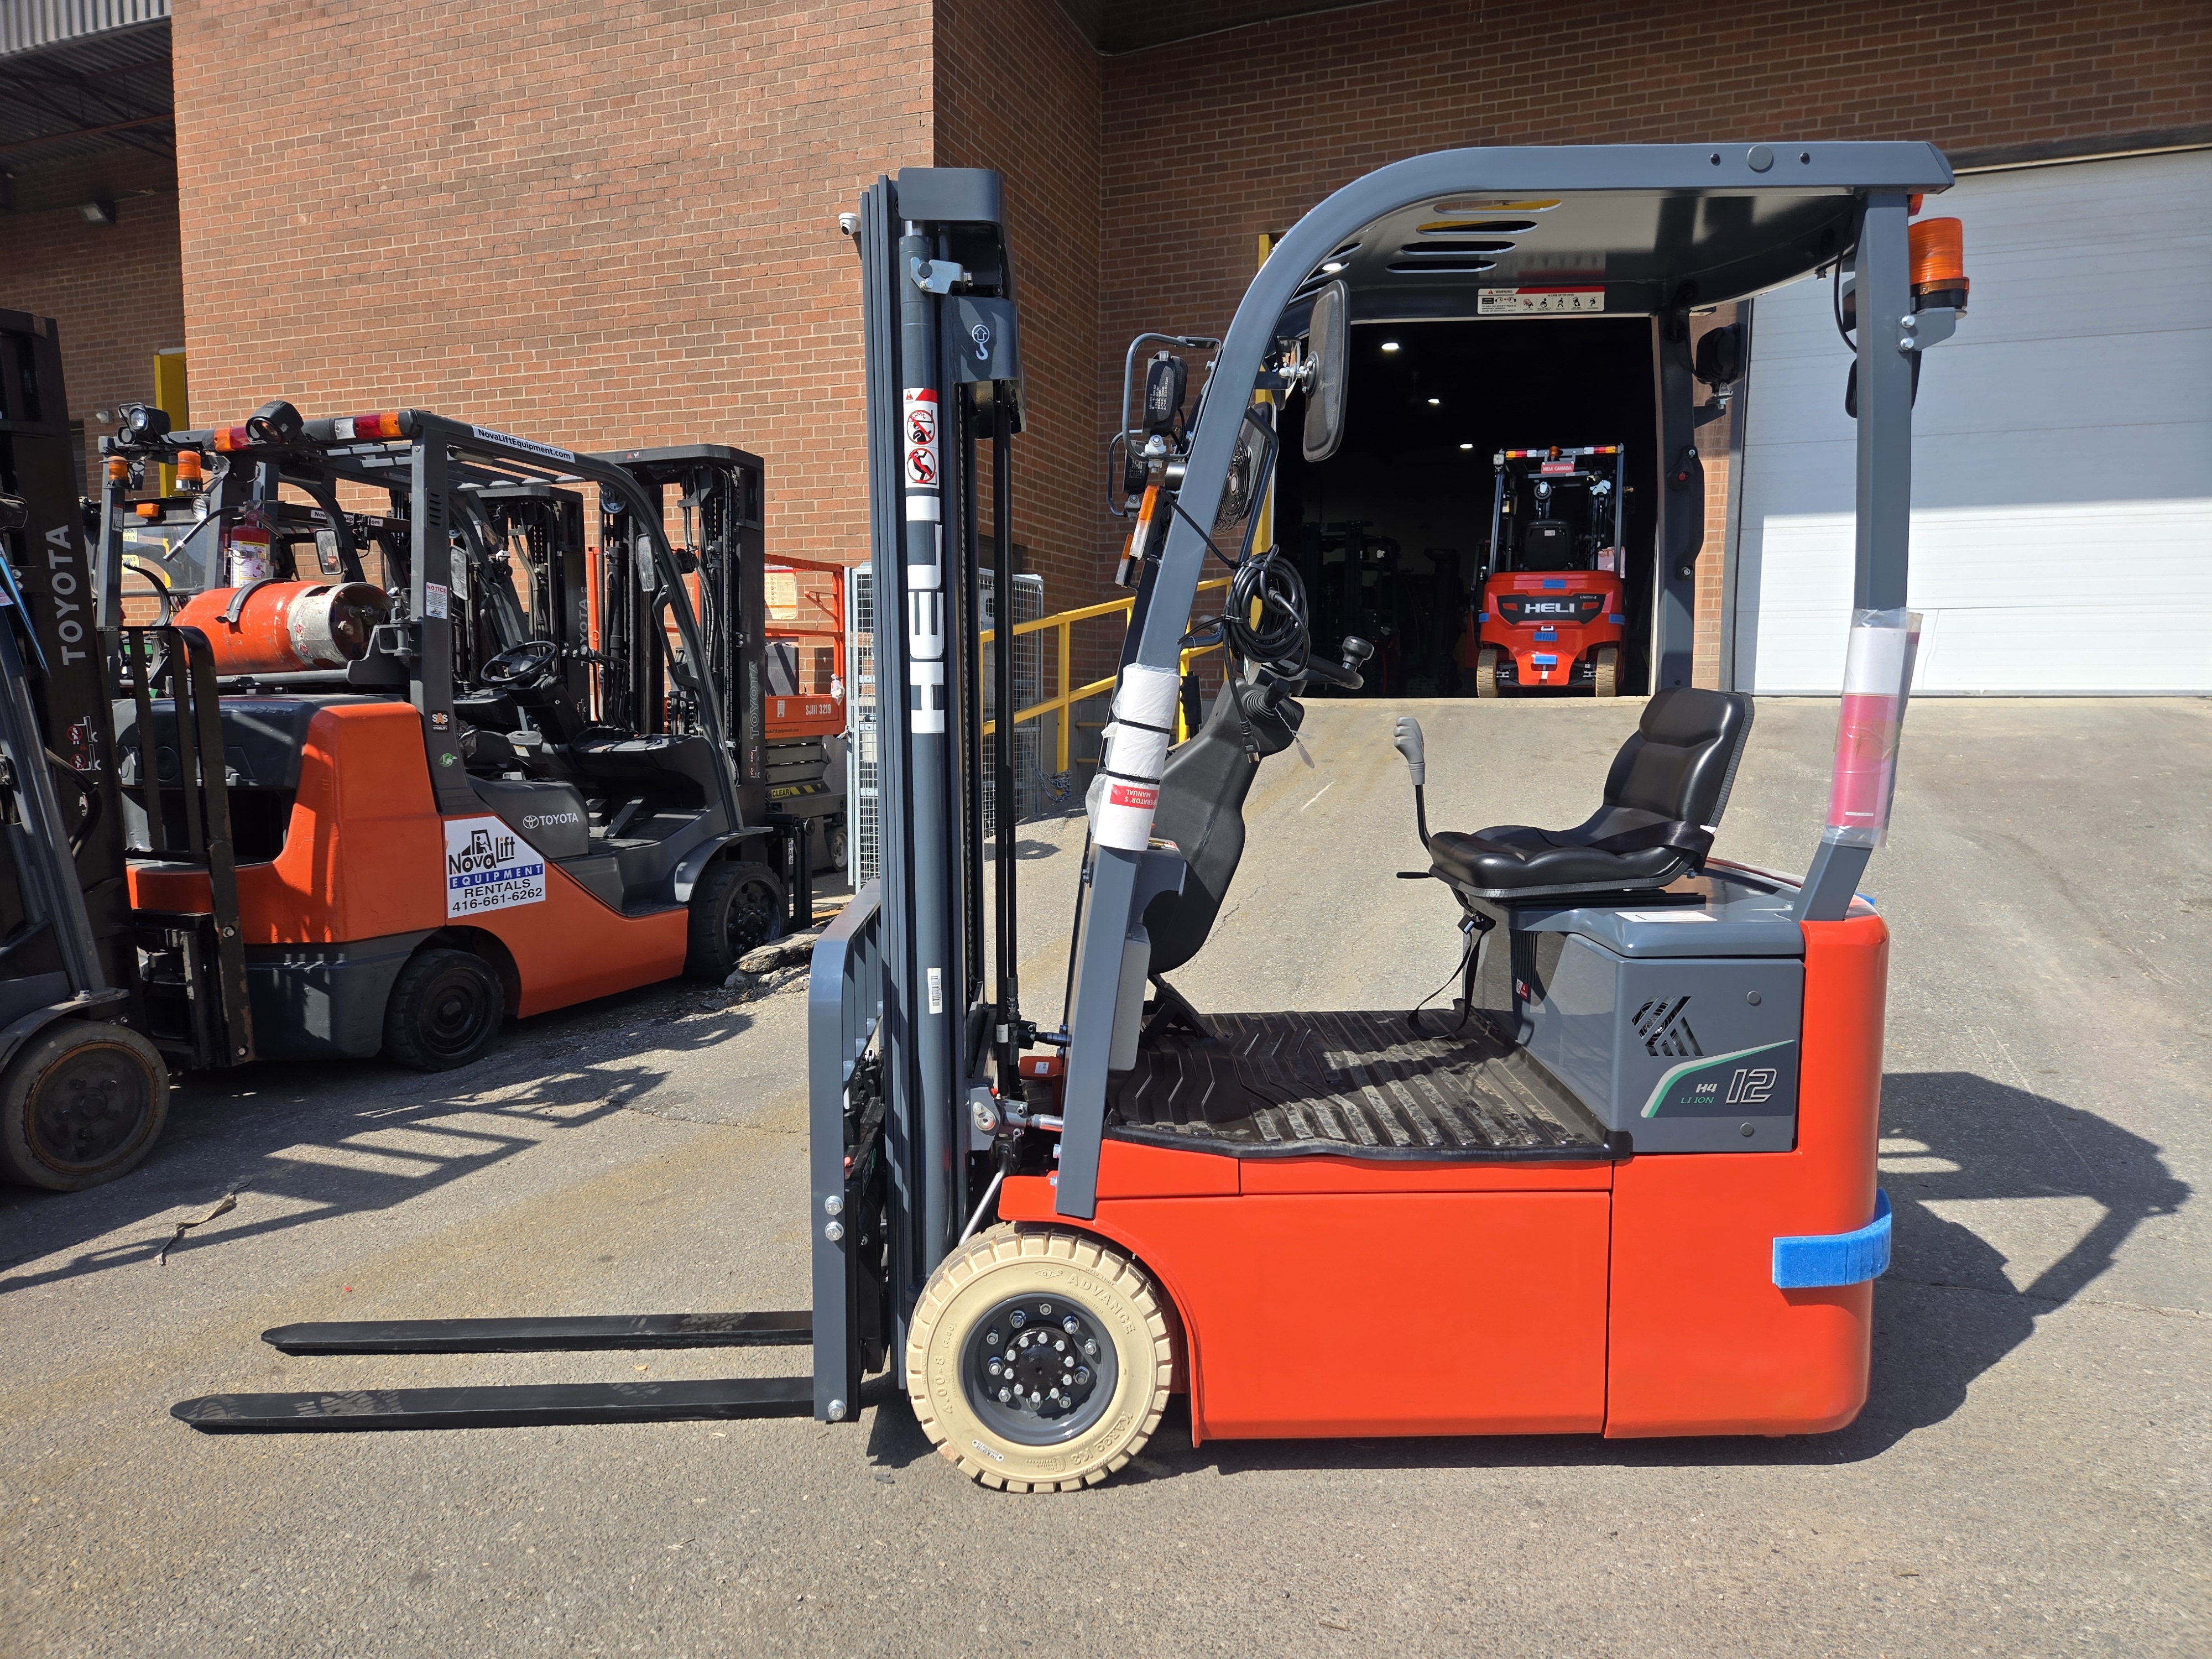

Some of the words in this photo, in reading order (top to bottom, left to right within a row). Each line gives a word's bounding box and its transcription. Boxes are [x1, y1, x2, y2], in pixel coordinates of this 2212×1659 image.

[478, 428, 571, 460] NovaLiftEquipment.com
[45, 525, 86, 665] TOYOTA
[427, 585, 447, 593] NOTICE
[905, 495, 945, 734] HELI
[1525, 603, 1575, 613] HELI
[748, 660, 759, 740] TOYOTA
[819, 703, 831, 714] 3219
[431, 712, 448, 724] SAS
[772, 789, 790, 797] CLEAR
[1126, 789, 1151, 798] MANUAL
[539, 812, 579, 826] TOYOTA
[452, 864, 541, 888] EQUIPMENT
[452, 888, 542, 911] 416-661-6262
[464, 878, 531, 899] RENTALS
[1695, 1083, 1718, 1093] H4
[1725, 1068, 1777, 1105] 12
[1067, 1273, 1136, 1334] ADVANCE
[934, 1355, 953, 1414] 4.00-8
